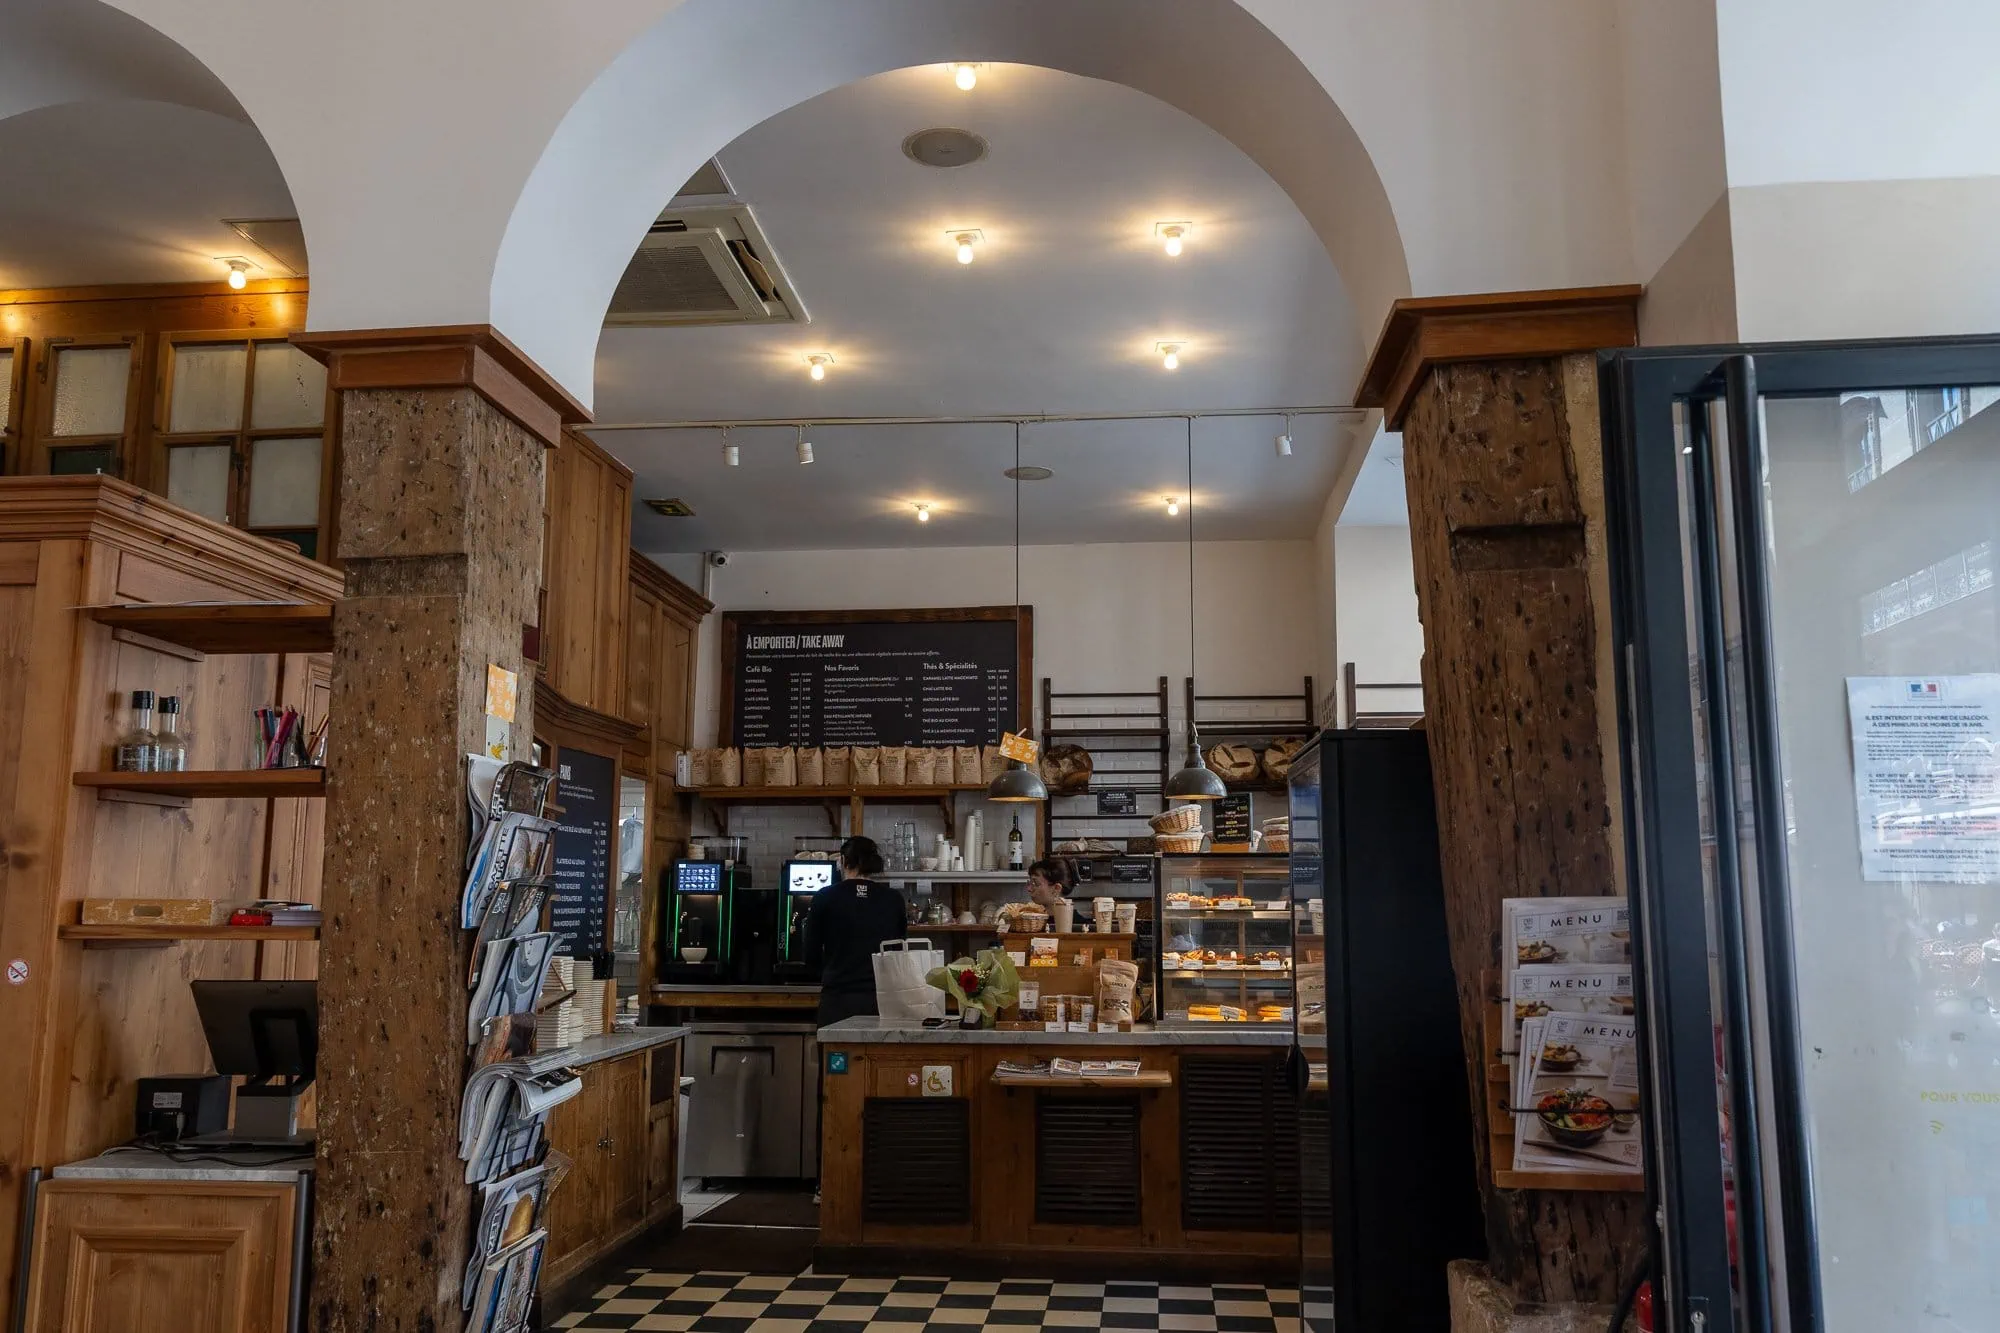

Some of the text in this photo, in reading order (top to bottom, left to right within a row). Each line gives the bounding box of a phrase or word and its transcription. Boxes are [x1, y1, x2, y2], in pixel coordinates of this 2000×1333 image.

[746, 634, 752, 649] À
[753, 635, 796, 649] EMPORTER
[802, 635, 821, 648] TAKE
[822, 635, 845, 648] AWAY
[745, 665, 772, 673] Café Bio
[838, 664, 860, 672] Favoris
[945, 662, 978, 671] Spécialités
[1550, 914, 1602, 927] MENU
[1549, 979, 1602, 988] MENU
[1583, 1026, 1636, 1039] MENU
[1920, 1090, 1958, 1102] POUR
